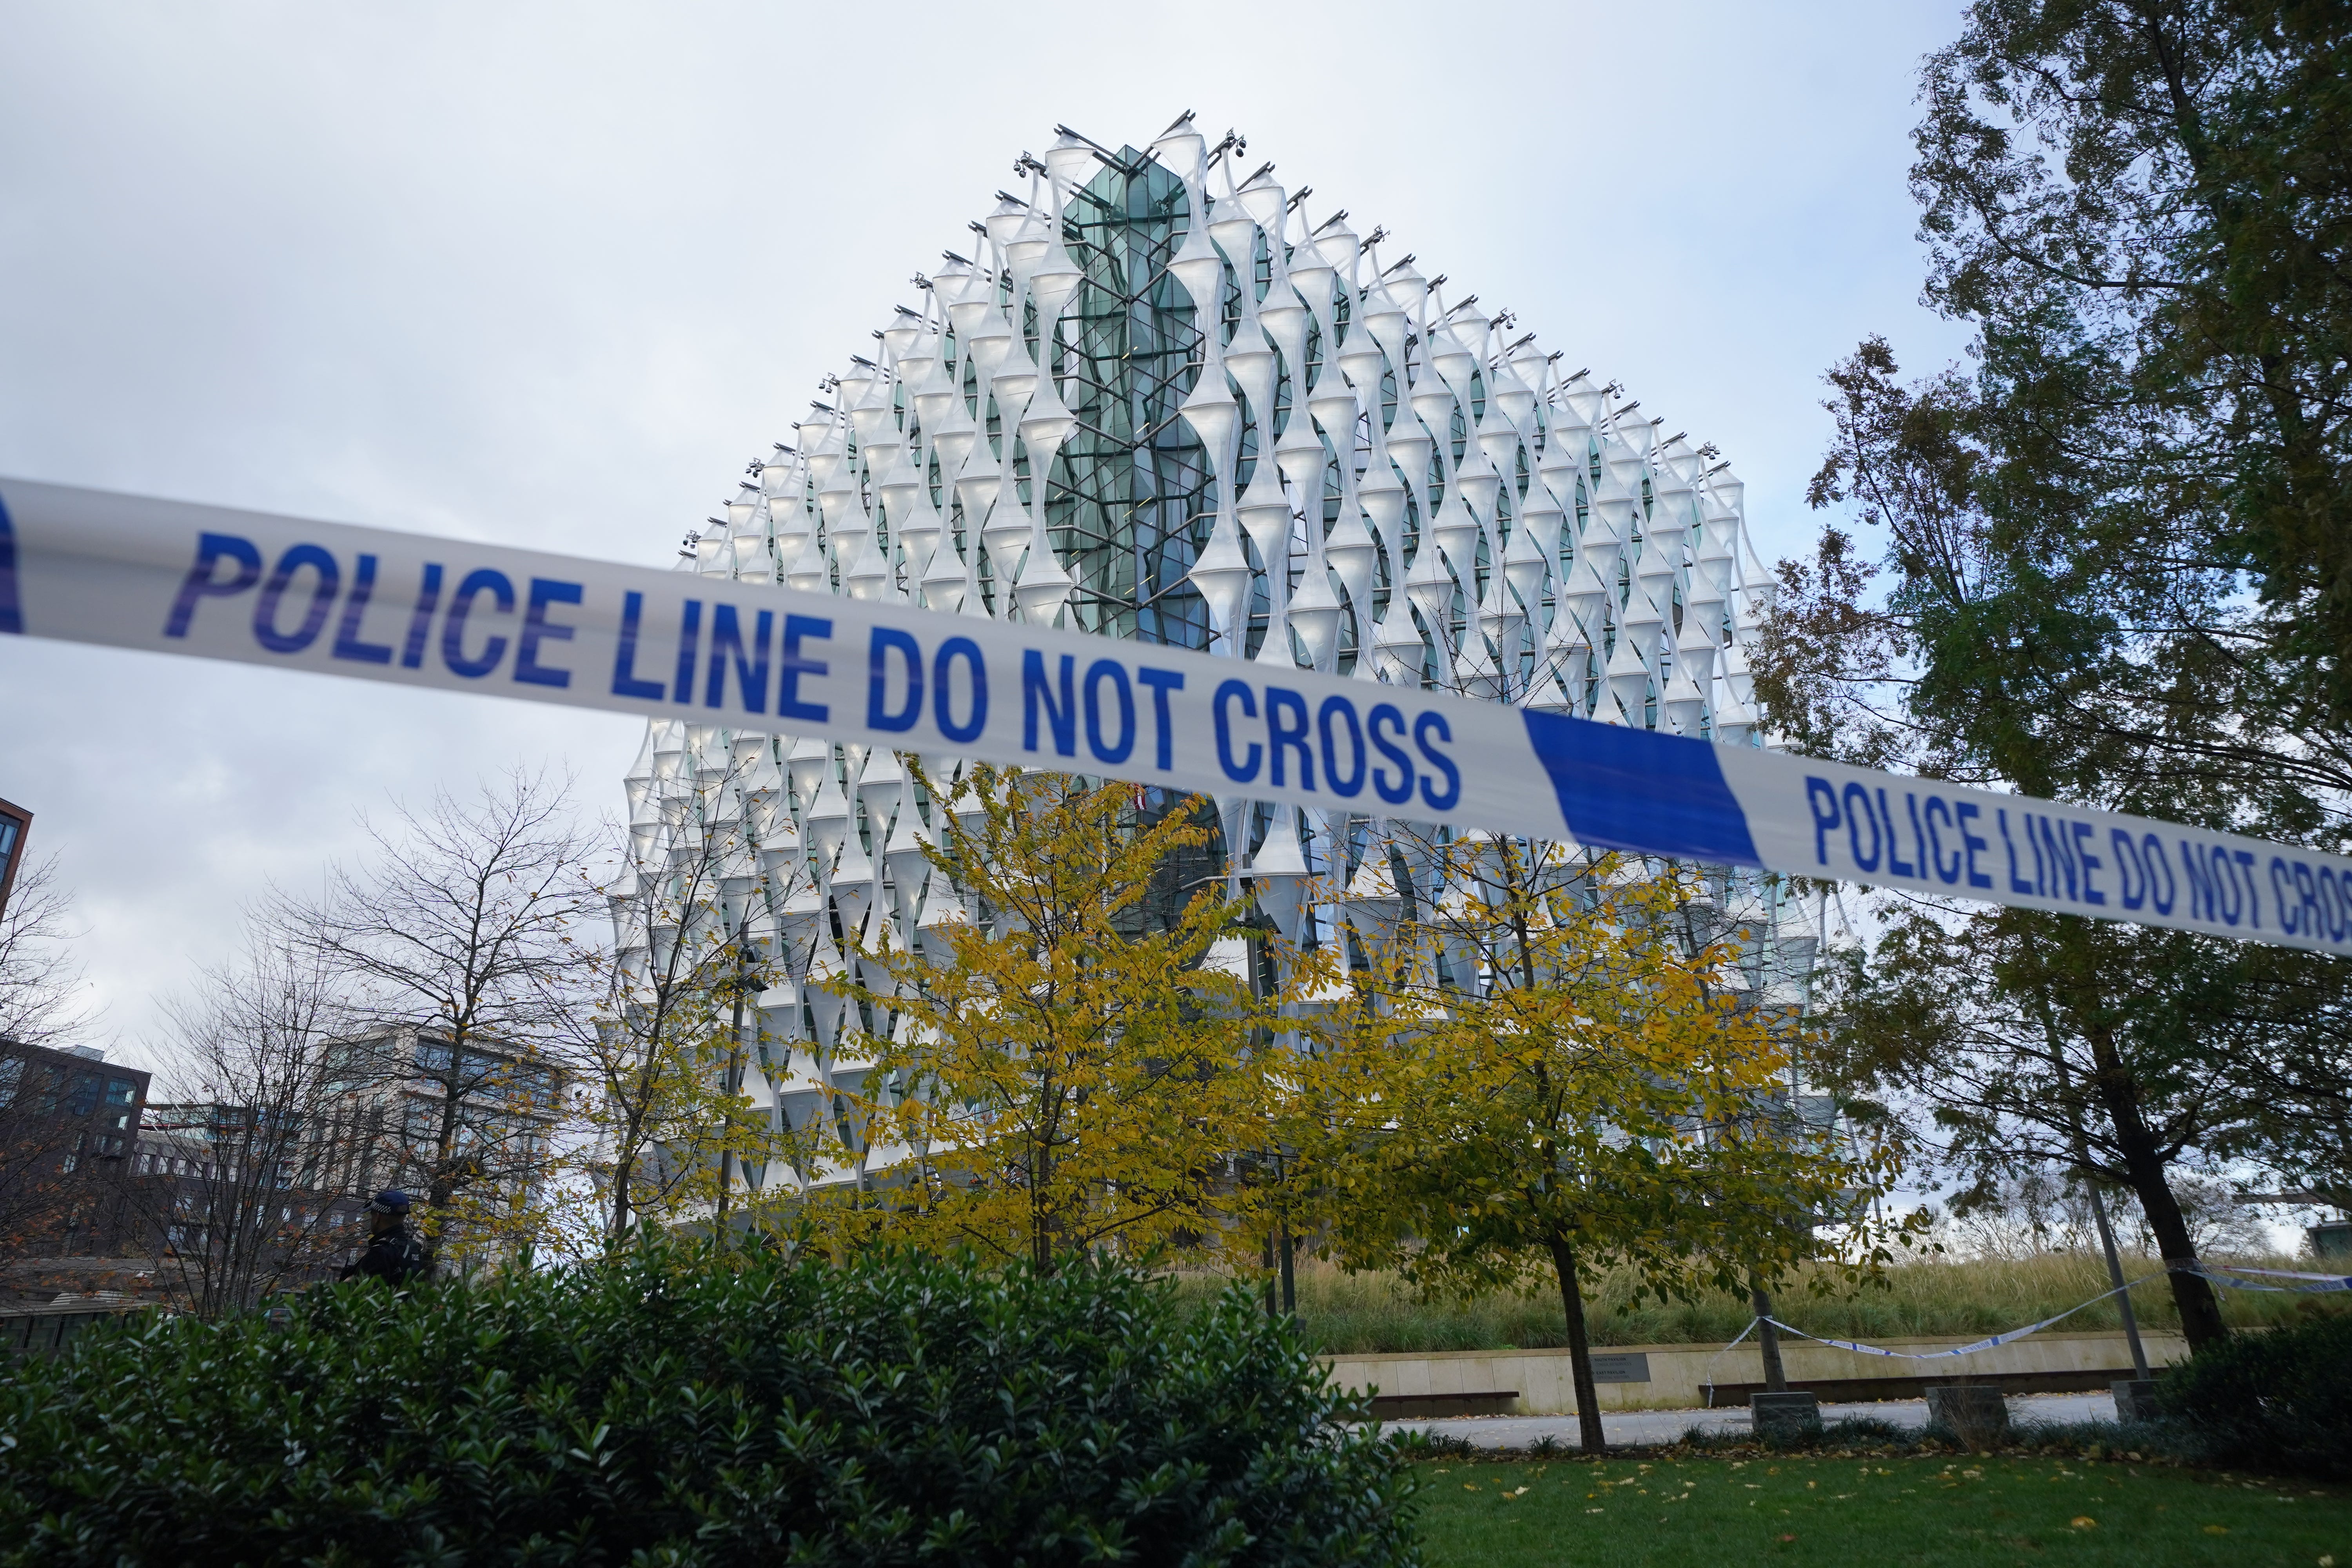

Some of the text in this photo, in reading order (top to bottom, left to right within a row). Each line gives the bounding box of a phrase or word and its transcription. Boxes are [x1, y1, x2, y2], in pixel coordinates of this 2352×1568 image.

[164, 529, 1463, 813] POLICE LINE DO NOT CROSS
[1804, 775, 1993, 890] POLICE
[1995, 807, 2107, 906] LINE
[2109, 827, 2177, 917] DO
[2179, 840, 2260, 929] NOT
